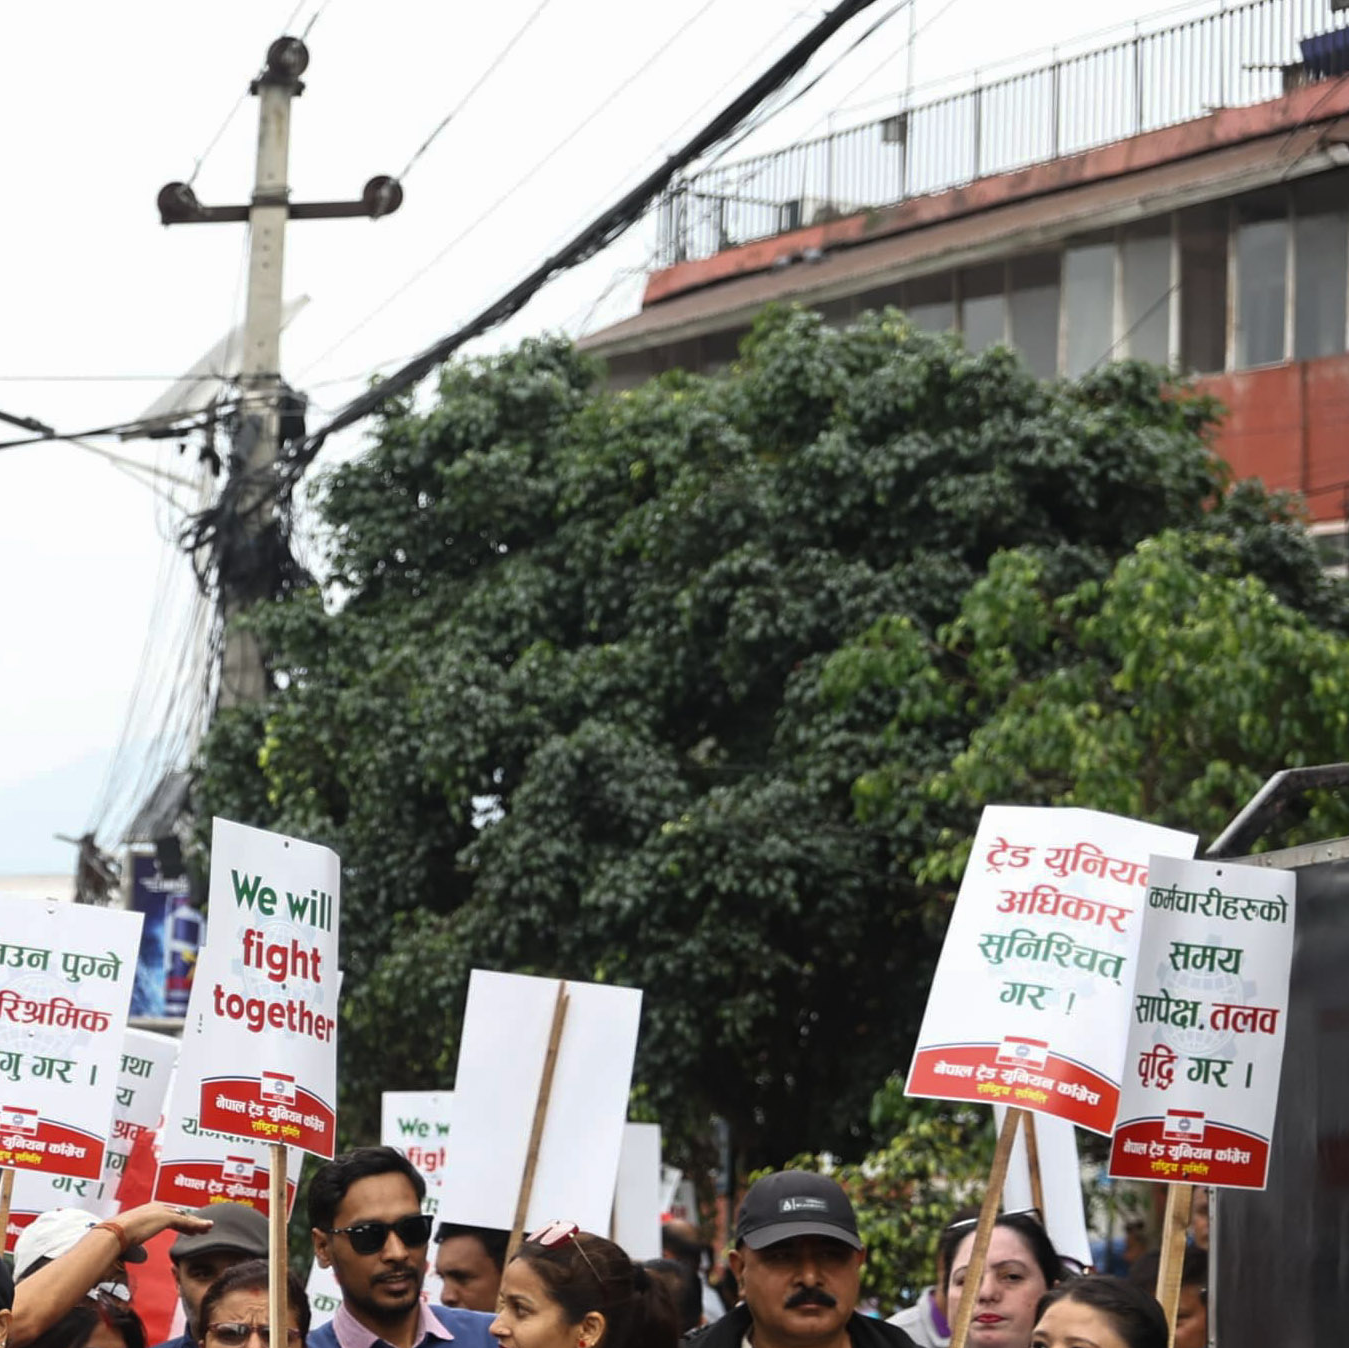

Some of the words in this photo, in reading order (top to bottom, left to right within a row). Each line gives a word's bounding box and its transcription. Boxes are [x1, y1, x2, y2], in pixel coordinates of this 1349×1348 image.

[986, 837, 1036, 873] ट्रेड
[231, 868, 278, 916] We
[286, 890, 332, 932] will
[997, 884, 1134, 933] अधिकार
[61, 951, 123, 983] पुग्ने
[242, 928, 321, 983] fight
[1169, 941, 1244, 974] समय
[1000, 981, 1053, 1010] गर
[213, 984, 334, 1042] together
[1210, 1003, 1280, 1035] तलव
[32, 1054, 78, 1084] गर
[1187, 1057, 1233, 1088] गर
[215, 1093, 246, 1113] नेपाल
[398, 1118, 430, 1137] We
